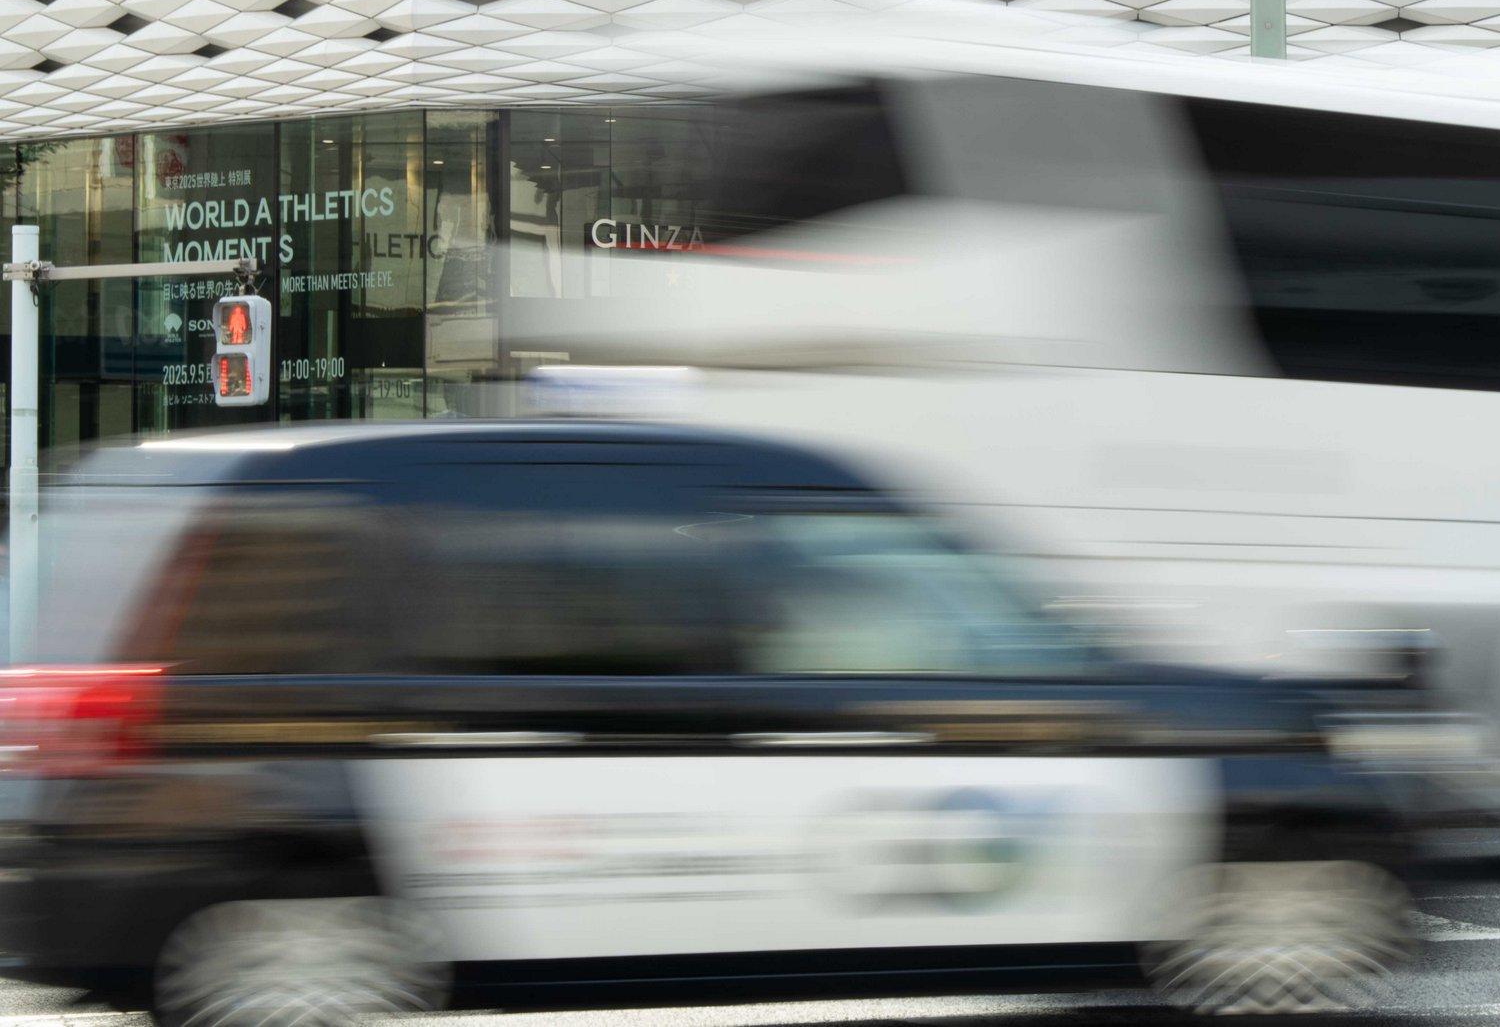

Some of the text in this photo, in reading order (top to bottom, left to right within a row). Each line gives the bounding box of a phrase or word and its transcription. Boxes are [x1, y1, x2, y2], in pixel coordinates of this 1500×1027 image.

[165, 199, 250, 231] WORLD
[591, 218, 705, 251] GINZA
[282, 275, 306, 293] MORE
[307, 274, 329, 291] THAN
[331, 272, 358, 290] MEETS
[360, 271, 375, 288] THE
[281, 356, 345, 380] 11:00-19:00
